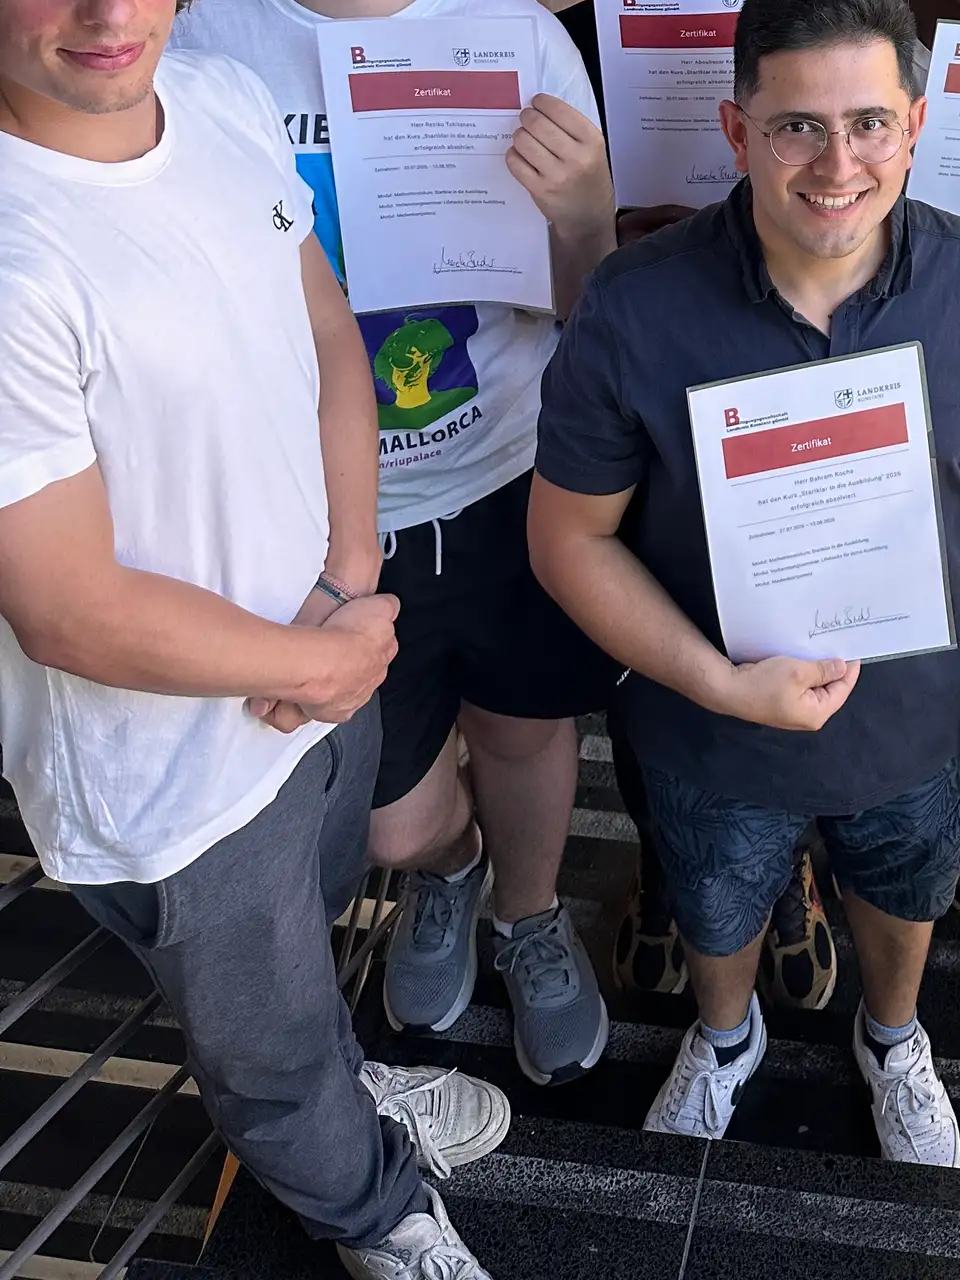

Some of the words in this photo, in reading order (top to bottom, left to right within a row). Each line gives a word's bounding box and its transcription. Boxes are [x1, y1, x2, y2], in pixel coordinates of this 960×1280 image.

[414, 88, 451, 97] Zertifikat
[857, 382, 901, 396] LANDKREIS
[791, 437, 832, 453] Zertifikat
[795, 478, 808, 486] Herr
[783, 492, 798, 500] Kurs
[790, 499, 824, 511] erfolgreich
[826, 493, 856, 503] absolviert
